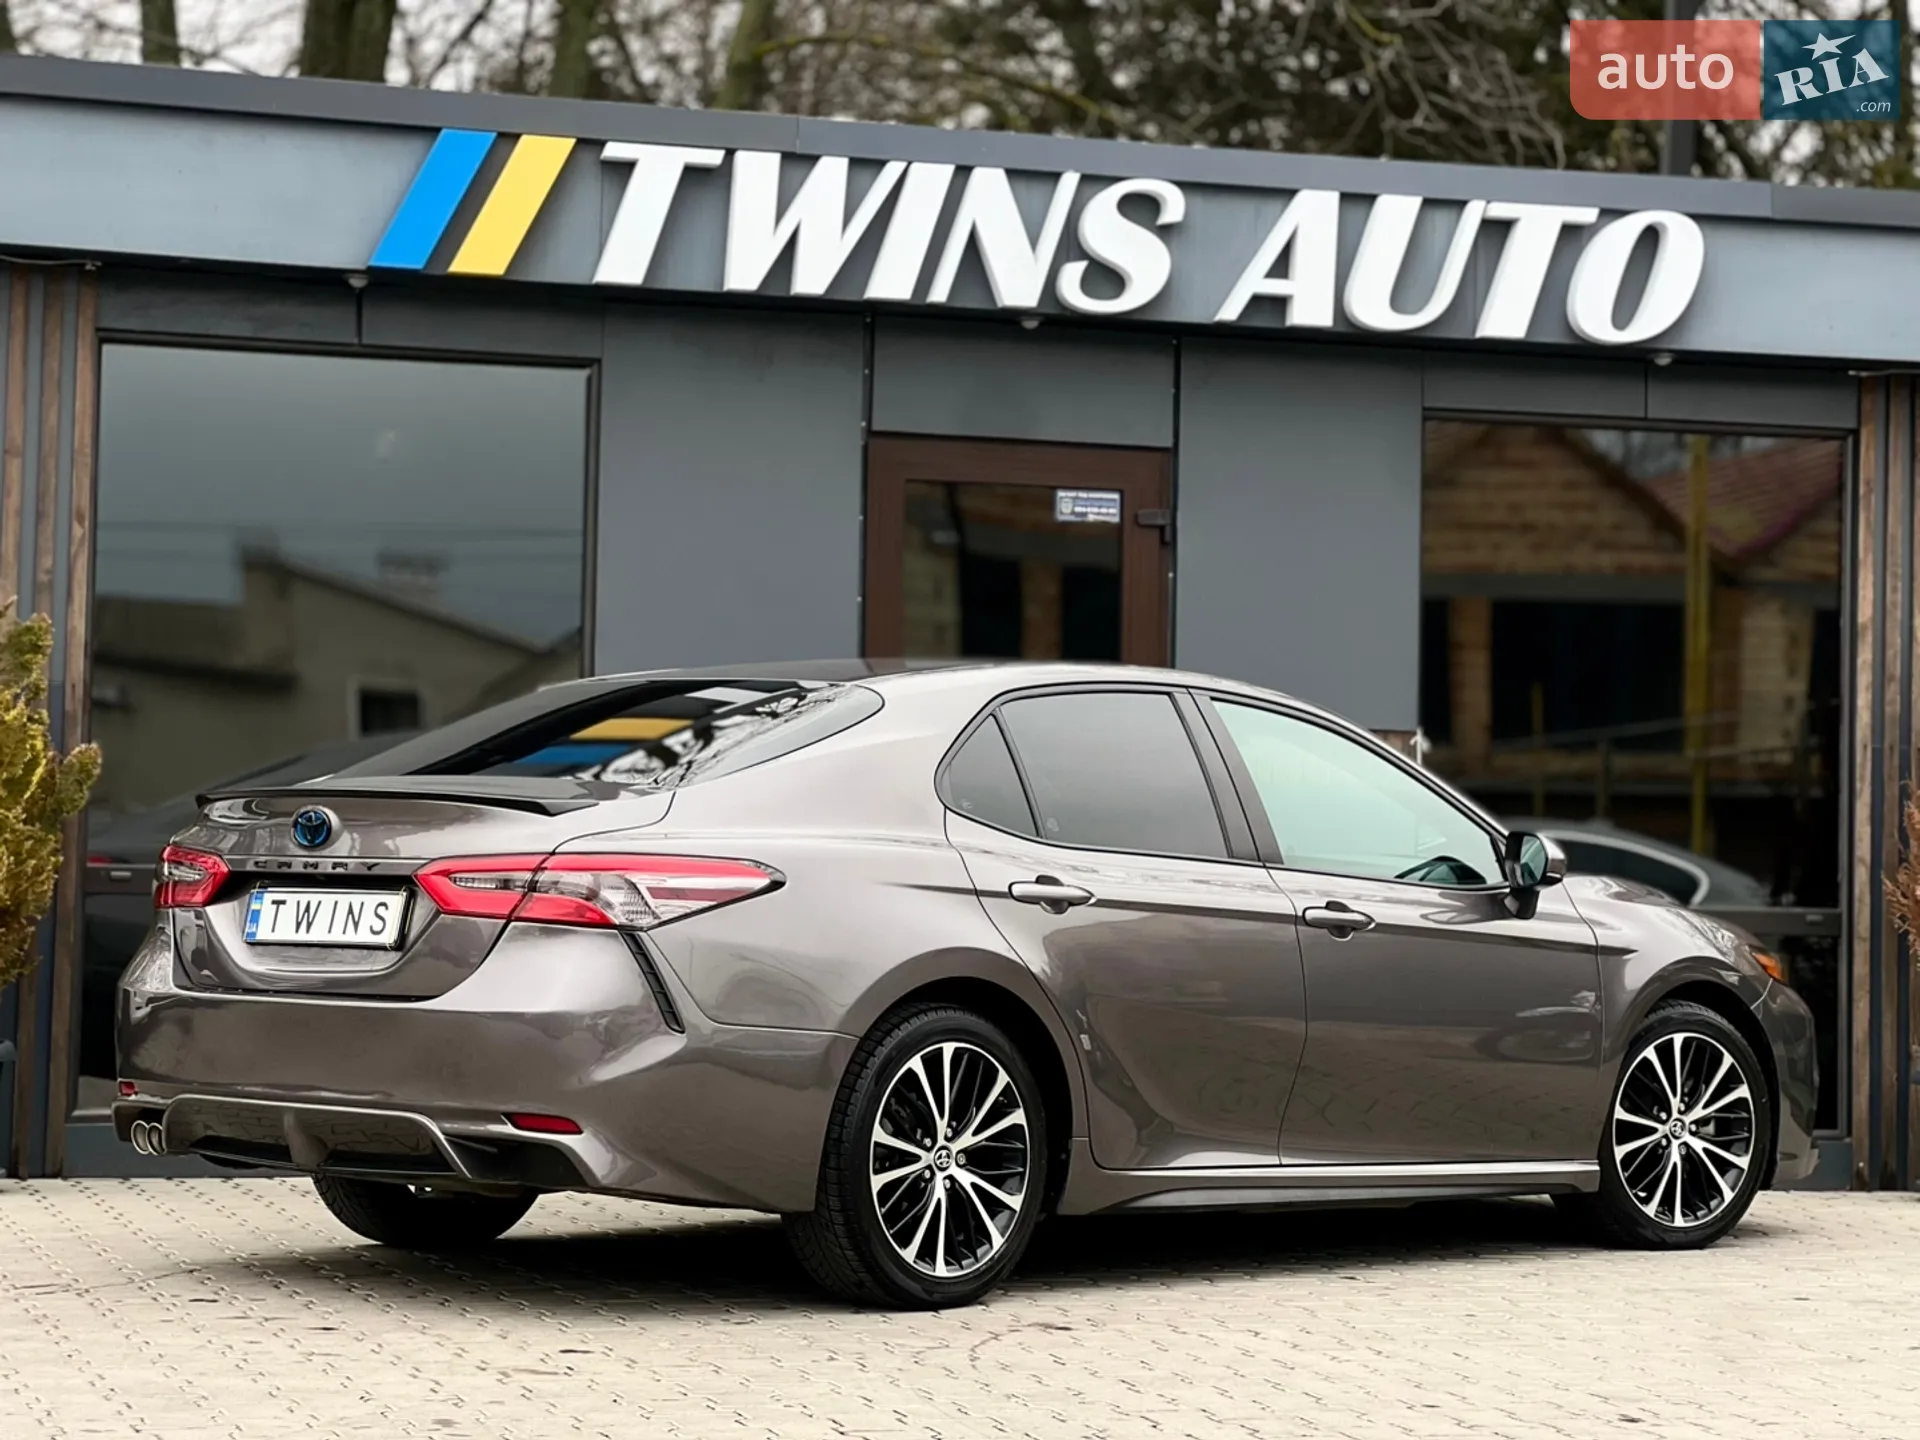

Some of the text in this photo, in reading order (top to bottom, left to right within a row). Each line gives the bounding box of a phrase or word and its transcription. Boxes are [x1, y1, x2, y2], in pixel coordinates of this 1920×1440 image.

[592, 141, 1705, 345] TWINS AUTO
[253, 860, 381, 871] CAMRY
[271, 899, 389, 935] TWINS
